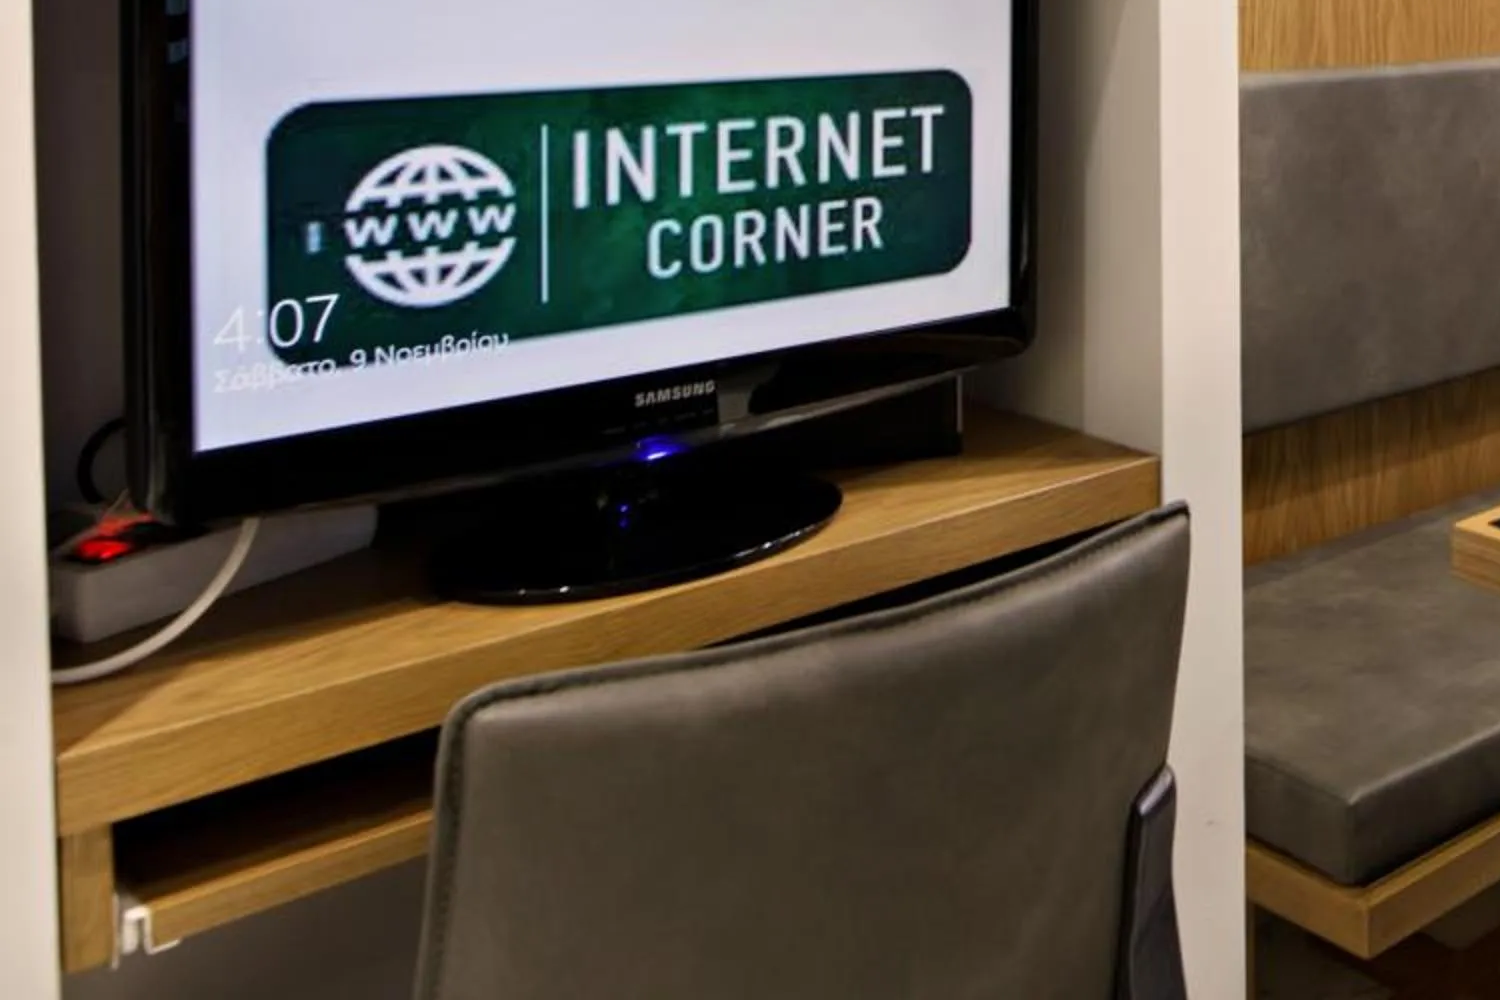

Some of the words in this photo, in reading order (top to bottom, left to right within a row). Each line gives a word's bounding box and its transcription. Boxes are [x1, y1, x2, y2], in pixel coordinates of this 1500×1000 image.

[571, 103, 947, 209] INTERNET
[646, 195, 885, 281] CORNER
[213, 293, 340, 353] 4:07
[350, 349, 367, 371] 9
[634, 379, 716, 408] SAMSUNG
